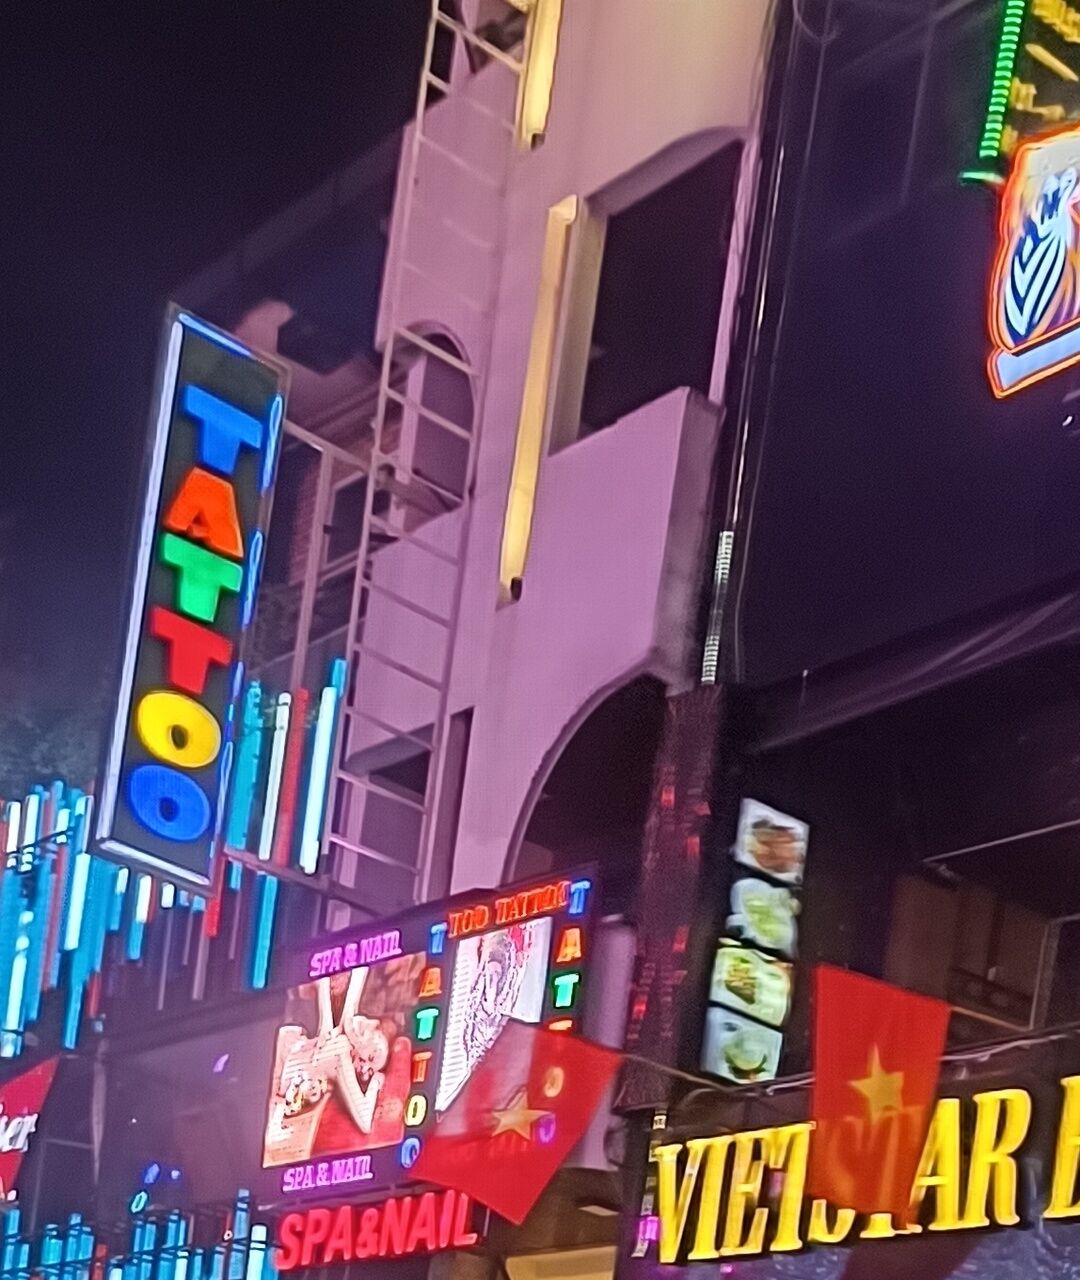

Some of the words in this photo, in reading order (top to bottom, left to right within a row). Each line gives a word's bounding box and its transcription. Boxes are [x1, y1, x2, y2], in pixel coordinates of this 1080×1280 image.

[127, 384, 265, 843] TATTOO
[309, 944, 343, 977] SPA
[400, 921, 448, 1169] TATTOO
[283, 1165, 316, 1192] SPA
